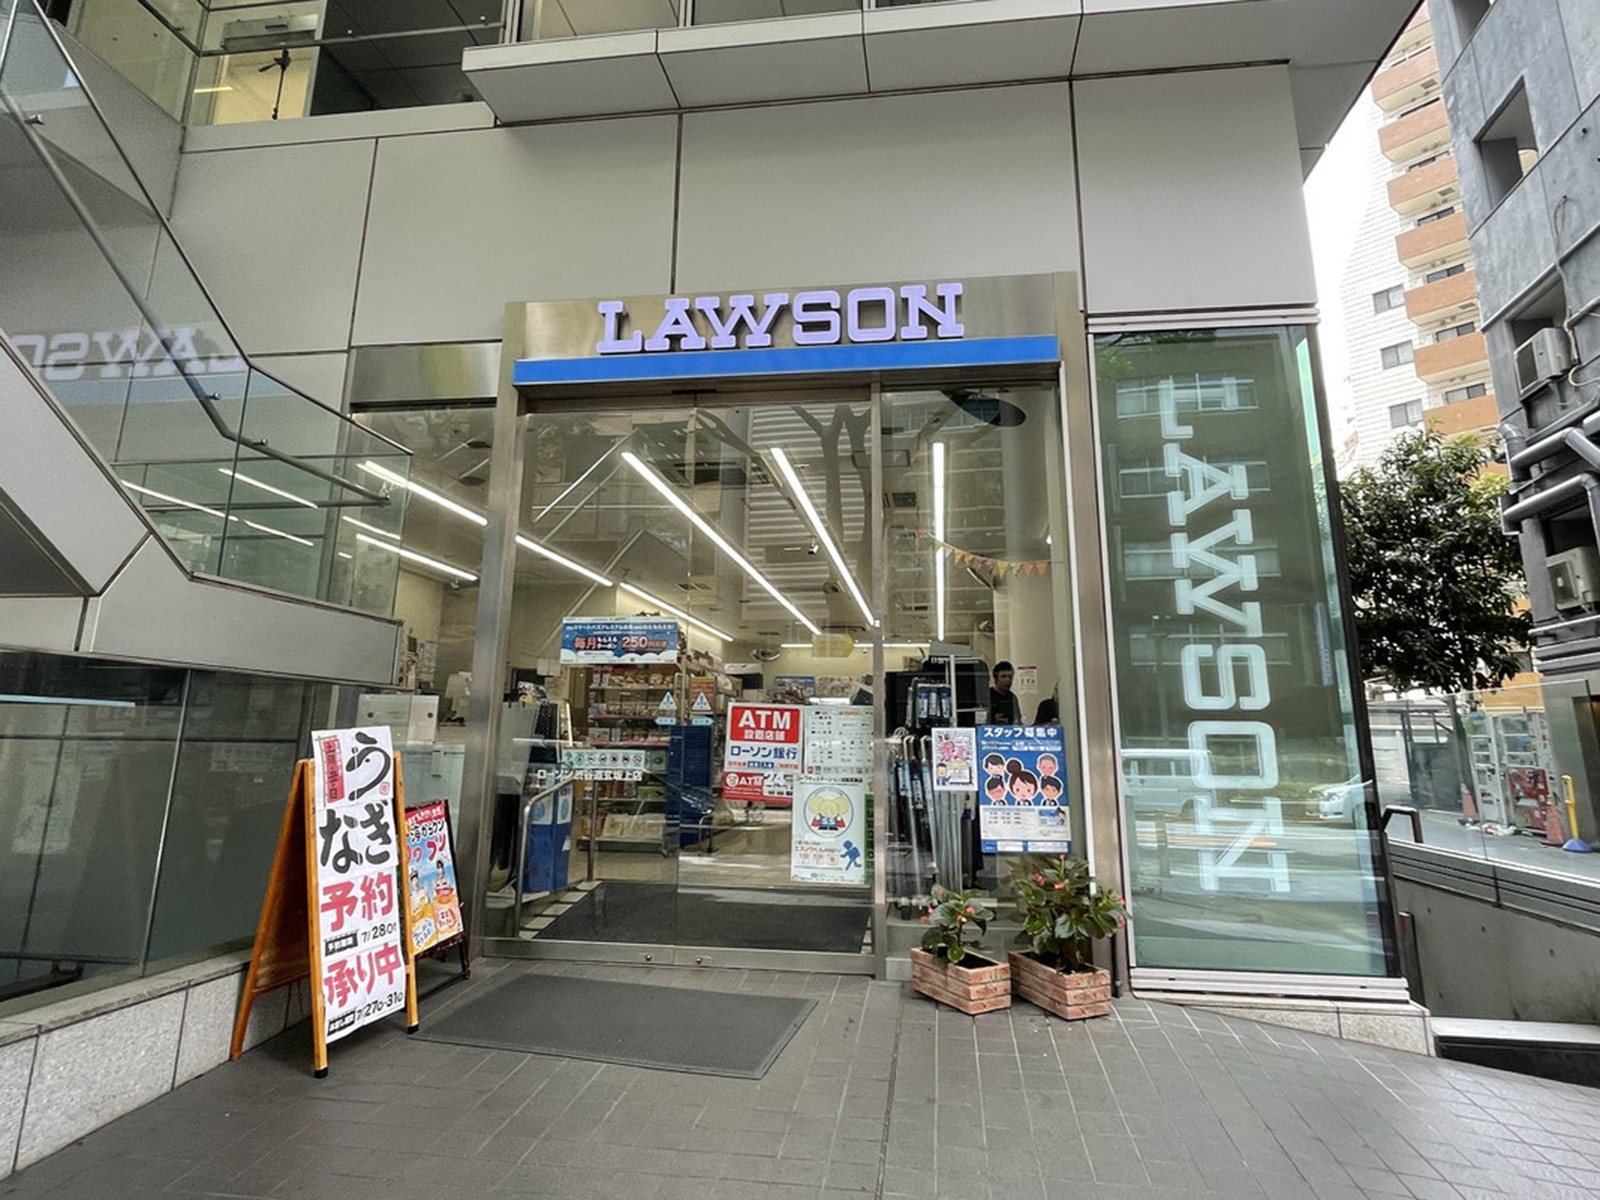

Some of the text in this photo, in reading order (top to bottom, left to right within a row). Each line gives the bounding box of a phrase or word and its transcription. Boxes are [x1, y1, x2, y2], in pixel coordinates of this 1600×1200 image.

[596, 282, 965, 354] LAWSON
[1159, 375, 1291, 893] LAWSON
[730, 745, 798, 760] ローソン銀行
[738, 709, 791, 730] ATM
[983, 727, 1058, 738] スタッフ募集中
[345, 731, 392, 801] う
[318, 800, 393, 874] なぎ
[320, 871, 394, 933] 予約
[323, 942, 401, 1009] 承り中
